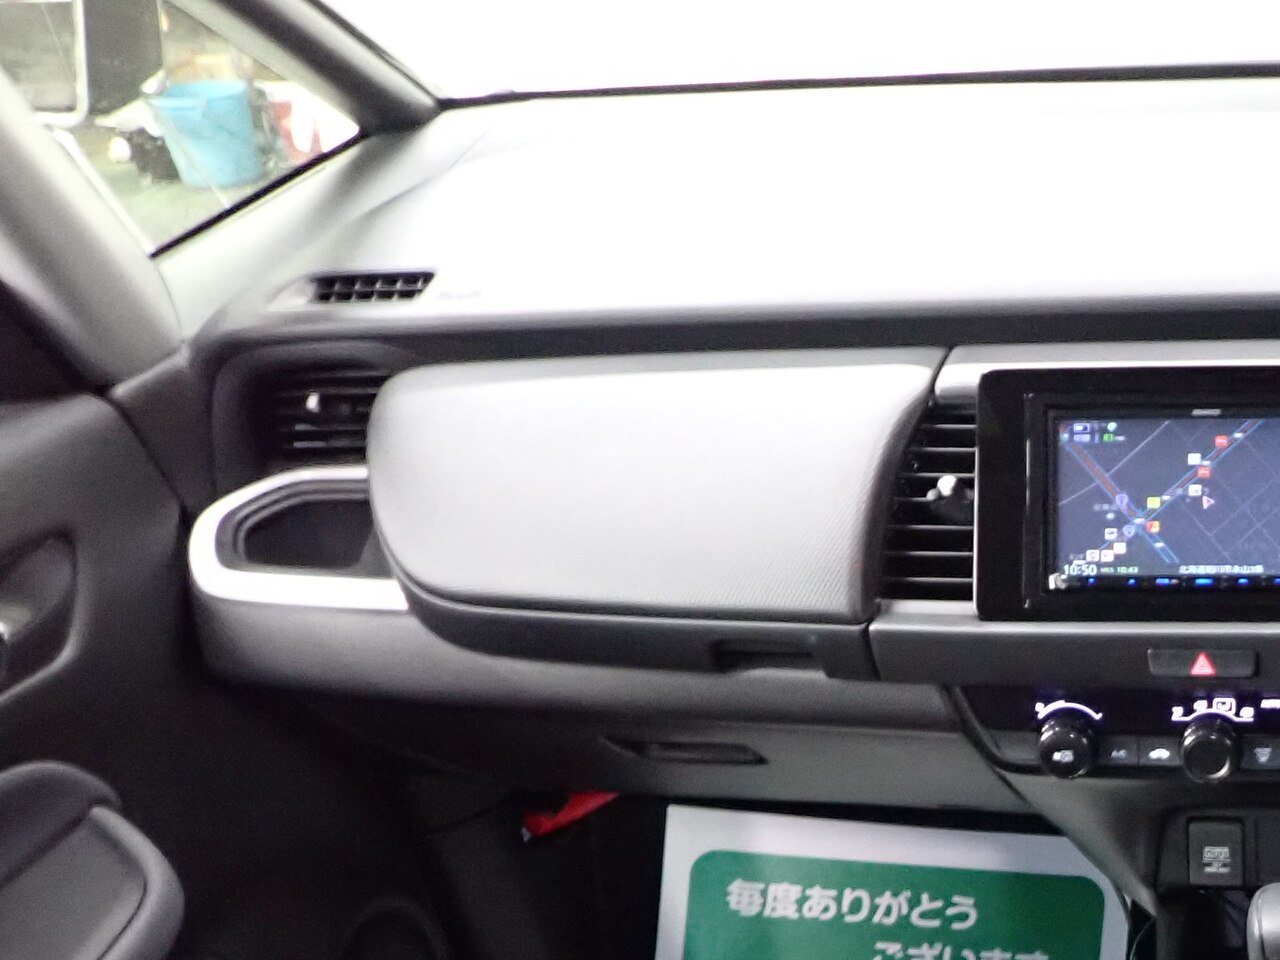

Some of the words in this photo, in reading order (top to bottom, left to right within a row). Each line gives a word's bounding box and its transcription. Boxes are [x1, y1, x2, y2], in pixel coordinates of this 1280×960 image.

[1063, 563, 1097, 576] 10:50
[726, 878, 978, 930] 毎度ありがとう
